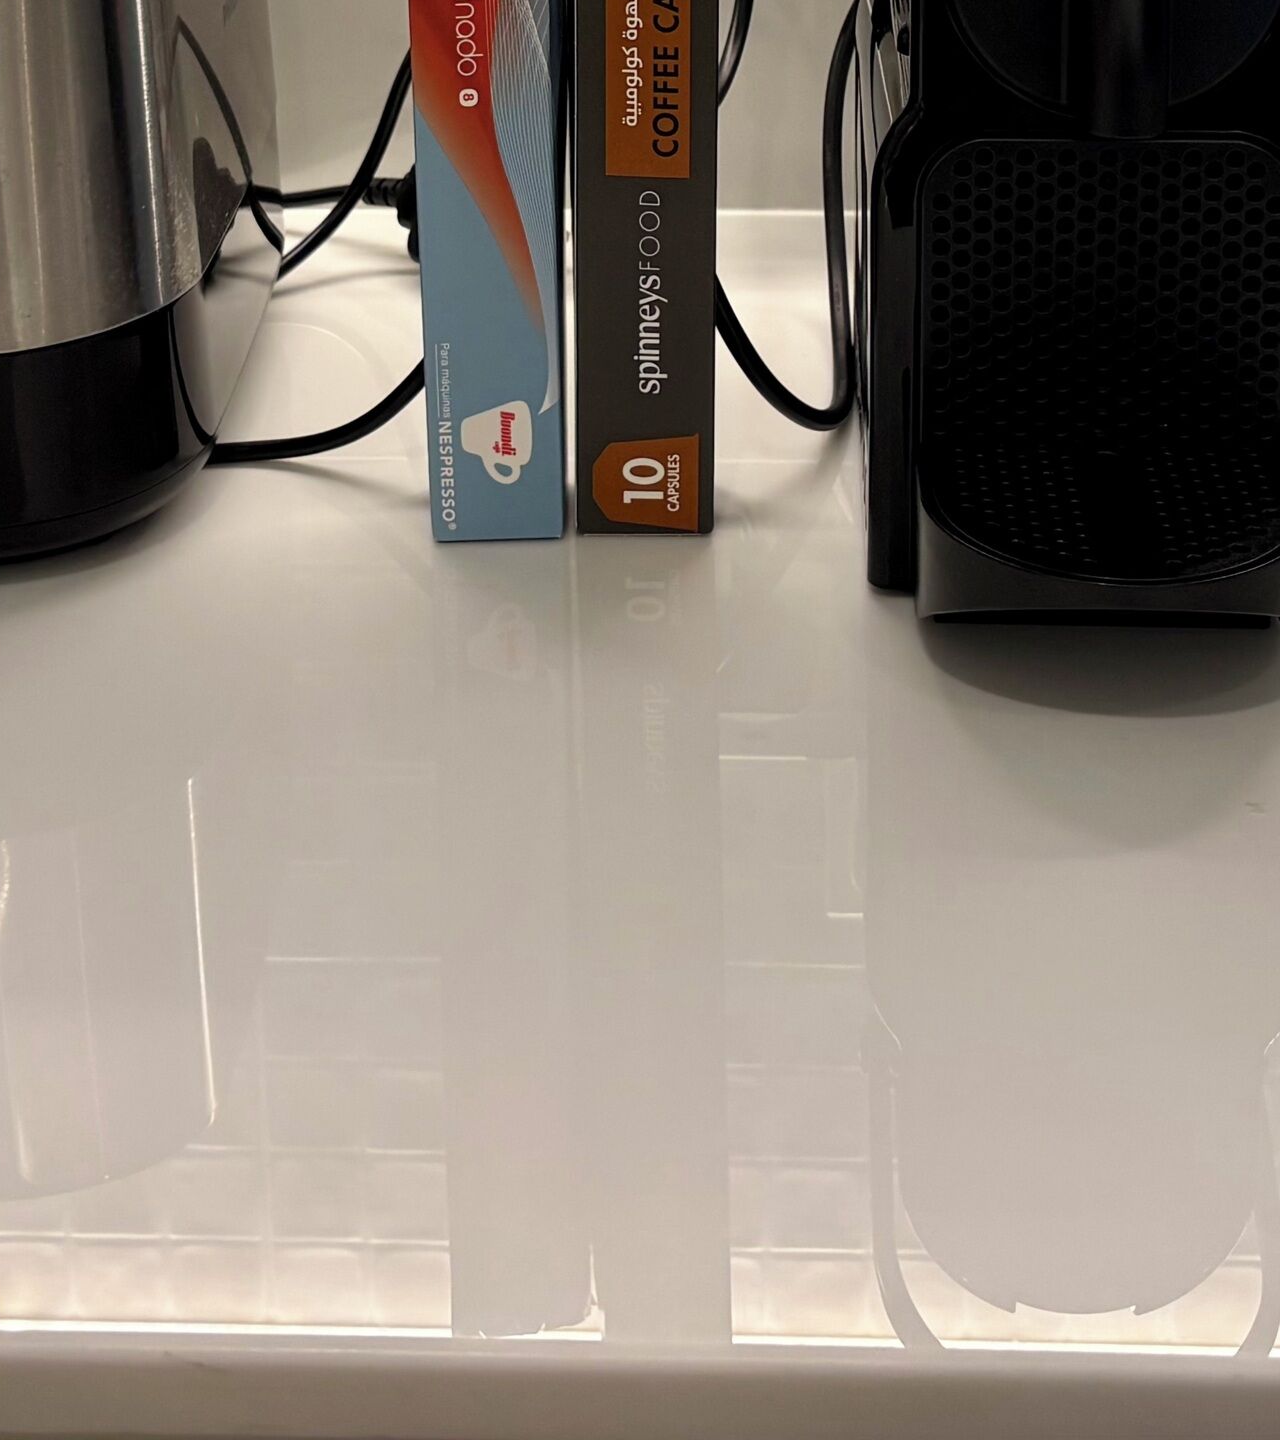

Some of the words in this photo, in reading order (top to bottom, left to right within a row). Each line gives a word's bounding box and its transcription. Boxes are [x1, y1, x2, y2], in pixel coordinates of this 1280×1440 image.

[621, 45, 644, 127] كولومبية
[651, 46, 680, 159] COFFEE
[439, 342, 452, 367] Para
[499, 410, 517, 457] Buondi
[622, 456, 666, 506] 10
[666, 453, 681, 513] CAPSULES
